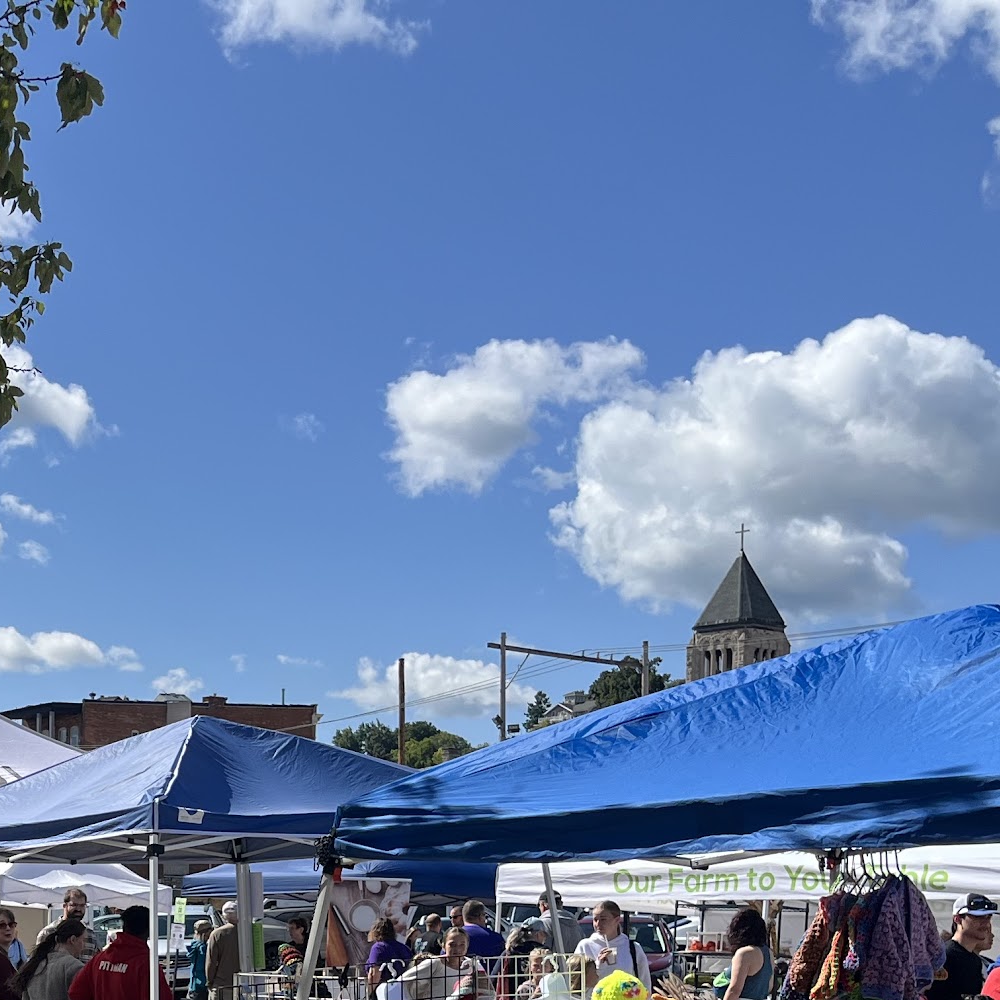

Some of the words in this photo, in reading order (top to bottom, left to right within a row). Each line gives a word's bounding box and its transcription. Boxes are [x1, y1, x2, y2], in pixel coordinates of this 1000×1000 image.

[613, 868, 662, 893] Our
[668, 867, 739, 893] Farm
[747, 867, 776, 891] to
[784, 864, 831, 891] You
